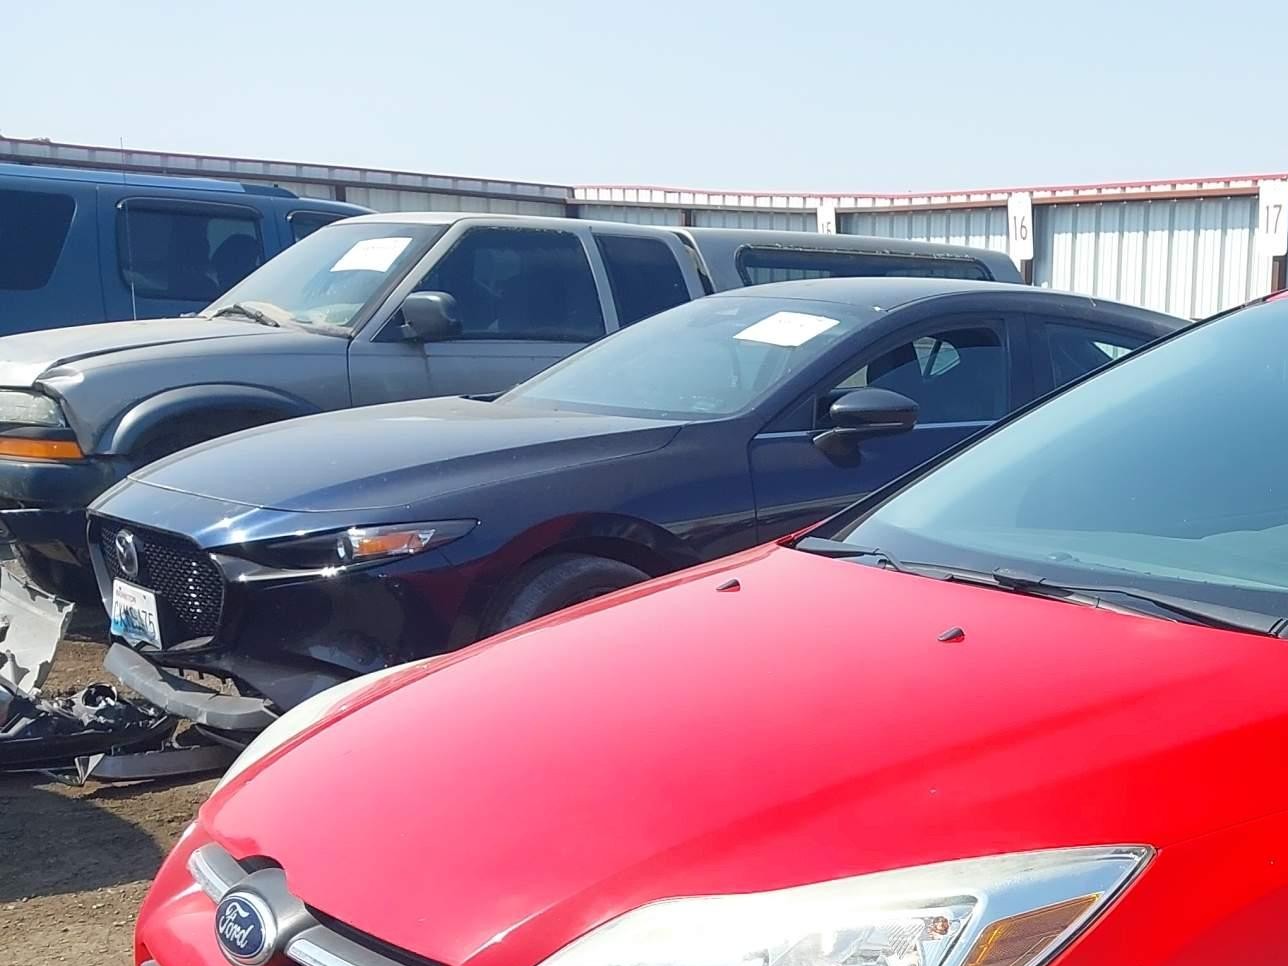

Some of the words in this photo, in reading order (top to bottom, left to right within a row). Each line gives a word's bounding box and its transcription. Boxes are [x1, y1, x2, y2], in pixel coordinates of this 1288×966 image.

[1013, 215, 1028, 241] 16
[1265, 204, 1282, 234] 17
[219, 901, 255, 949] Ford
